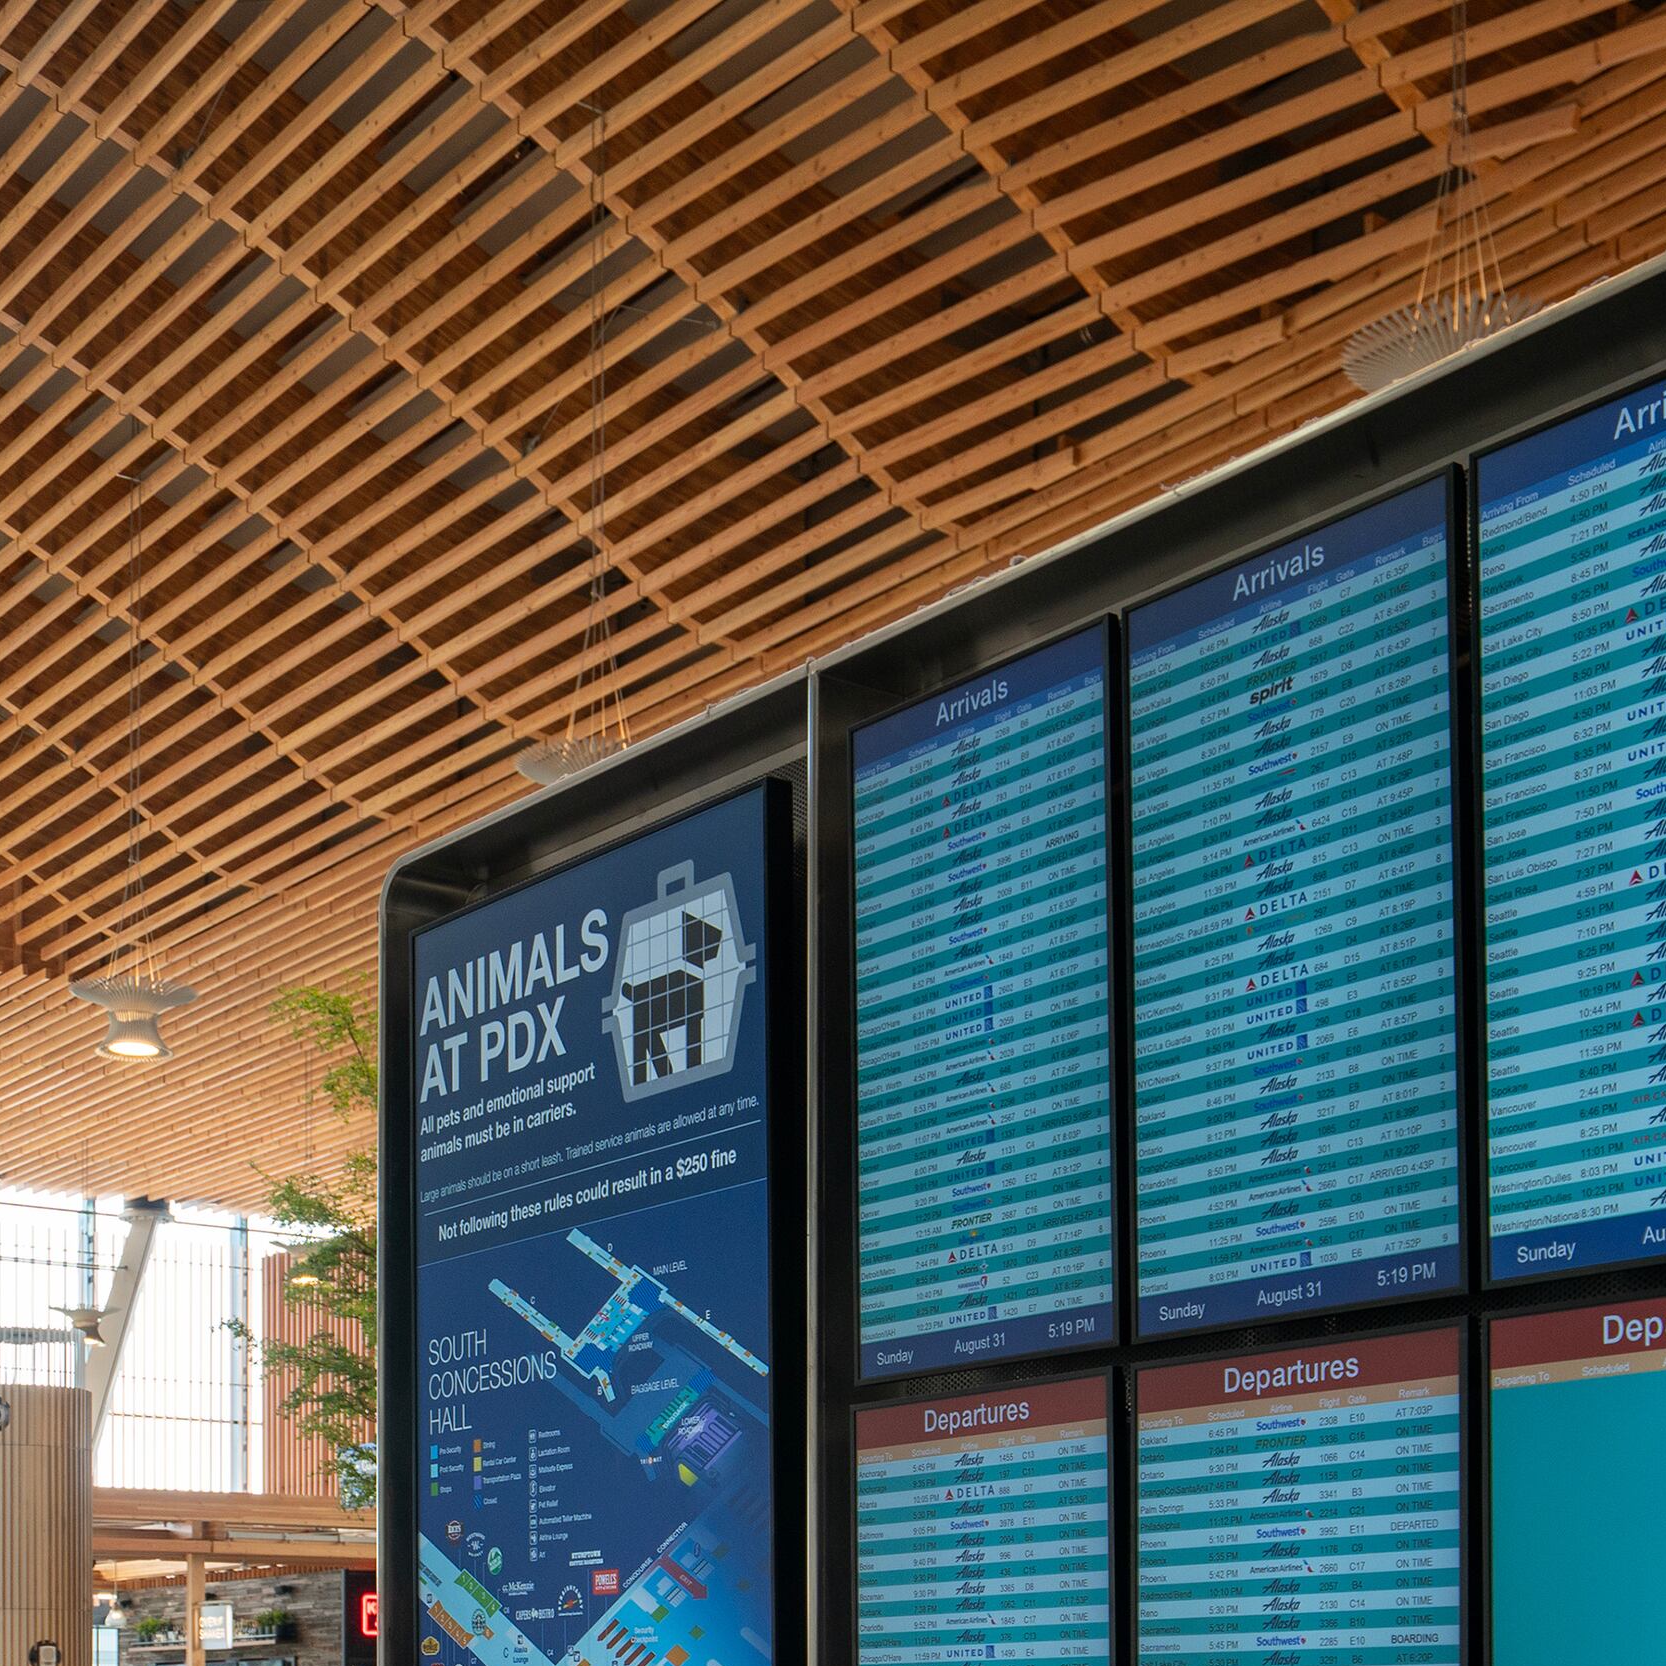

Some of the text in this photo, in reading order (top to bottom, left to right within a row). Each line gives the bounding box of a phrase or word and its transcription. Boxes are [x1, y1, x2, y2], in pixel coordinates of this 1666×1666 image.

[1482, 503, 1514, 521] Arriving
[1516, 492, 1538, 511] From
[1568, 459, 1616, 486] Scheduled
[1482, 505, 1548, 539] Redmond/Bend
[1570, 489, 1590, 504] 4:50
[1592, 482, 1607, 494] PM
[1230, 542, 1326, 603] Arrivals
[935, 677, 1009, 728] Arrivals
[1250, 676, 1295, 705] spirit
[419, 908, 610, 1037] ANIMALS
[419, 995, 567, 1103] AT PDX
[420, 1066, 595, 1136] All pets and emotional support
[420, 1101, 576, 1163] animals must be in carriers.
[420, 1094, 759, 1204] Large animals should be on a short leash. Trained service animals are allowed at any time.
[438, 1147, 737, 1242] Not following these rules could result in a $250 fine
[652, 1260, 688, 1276] MAIN LEVEL
[1517, 1241, 1576, 1263] Sunday
[1159, 1261, 1436, 1321] Sunday August 31 5:19 PM
[428, 1328, 487, 1366] SOUTH
[876, 1317, 1095, 1366] Sunday August 31 5:19 PM
[428, 1350, 557, 1401] CONCESSIONS
[1225, 1357, 1360, 1397] Departures
[1494, 1373, 1536, 1388] Departing
[1538, 1370, 1550, 1382] To
[1581, 1362, 1629, 1377] Scheduled
[428, 1403, 472, 1436] HALL
[924, 1401, 1030, 1437] Departures
[623, 1521, 688, 1589] CONCOURSE CONNECTOR
